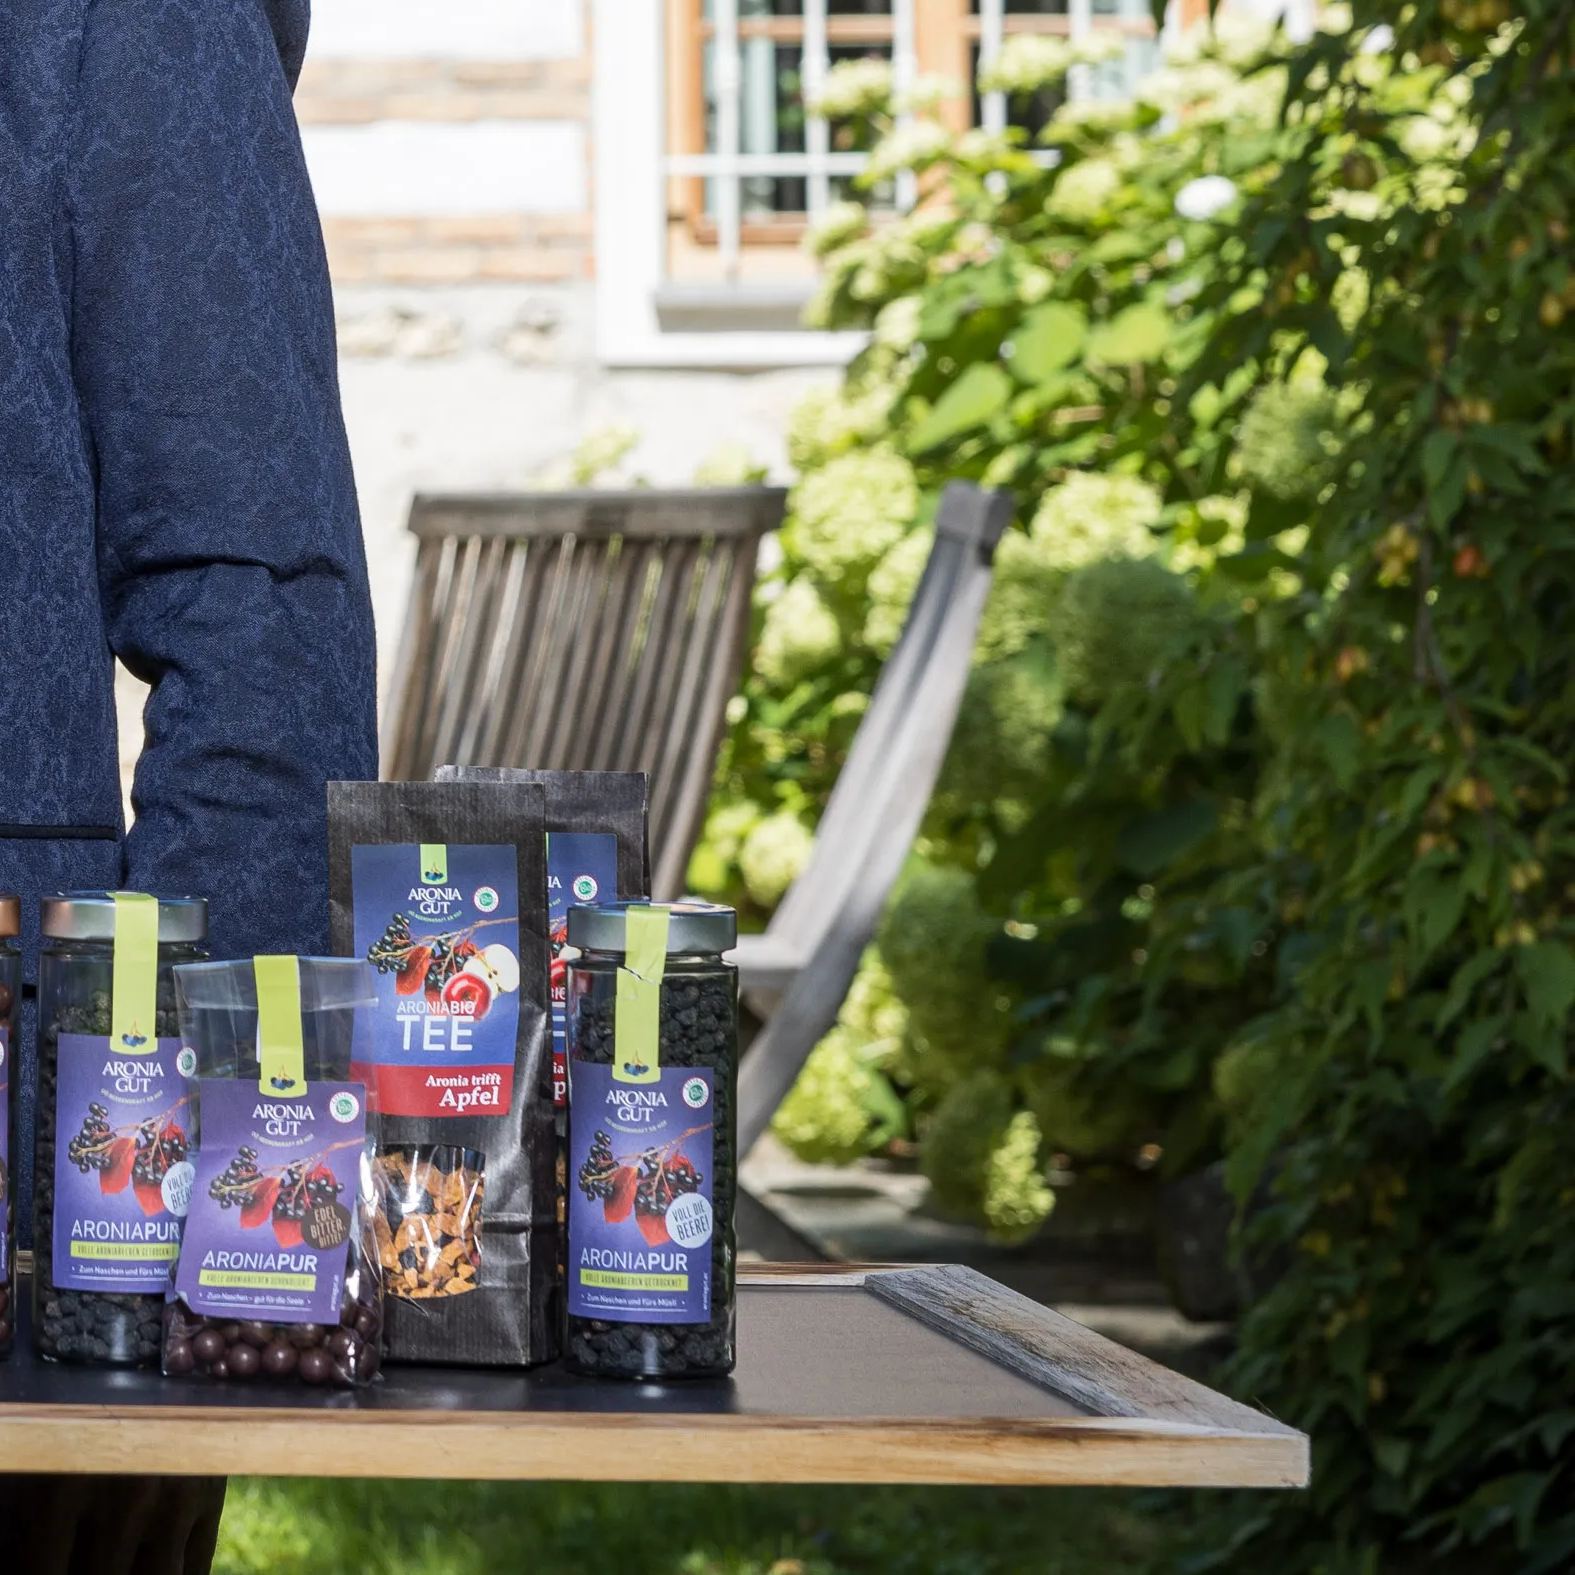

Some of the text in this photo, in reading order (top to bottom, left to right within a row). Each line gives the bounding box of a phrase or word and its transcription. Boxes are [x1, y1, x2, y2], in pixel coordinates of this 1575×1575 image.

[408, 888, 462, 903] ARONIA
[419, 901, 451, 914] GUT
[397, 1000, 476, 1015] ARONIABIO
[396, 1015, 474, 1051] TEE
[102, 1061, 164, 1079] ARONIA
[115, 1077, 151, 1093] GUT
[425, 1073, 501, 1087] Aronia trifft
[439, 1086, 499, 1112] Apfel
[605, 1089, 668, 1108] ARONIA
[252, 1104, 315, 1122] ARONIA
[617, 1106, 654, 1122] GUT
[266, 1121, 301, 1136] GUT
[314, 1205, 337, 1223] EDEL
[672, 1200, 706, 1223] VOLL DIE
[71, 1219, 180, 1241] ARONIAPUR
[676, 1215, 710, 1241] BEERE!
[202, 1250, 317, 1272] ARONIAPUR
[580, 1247, 688, 1272] ARONIAPUR
